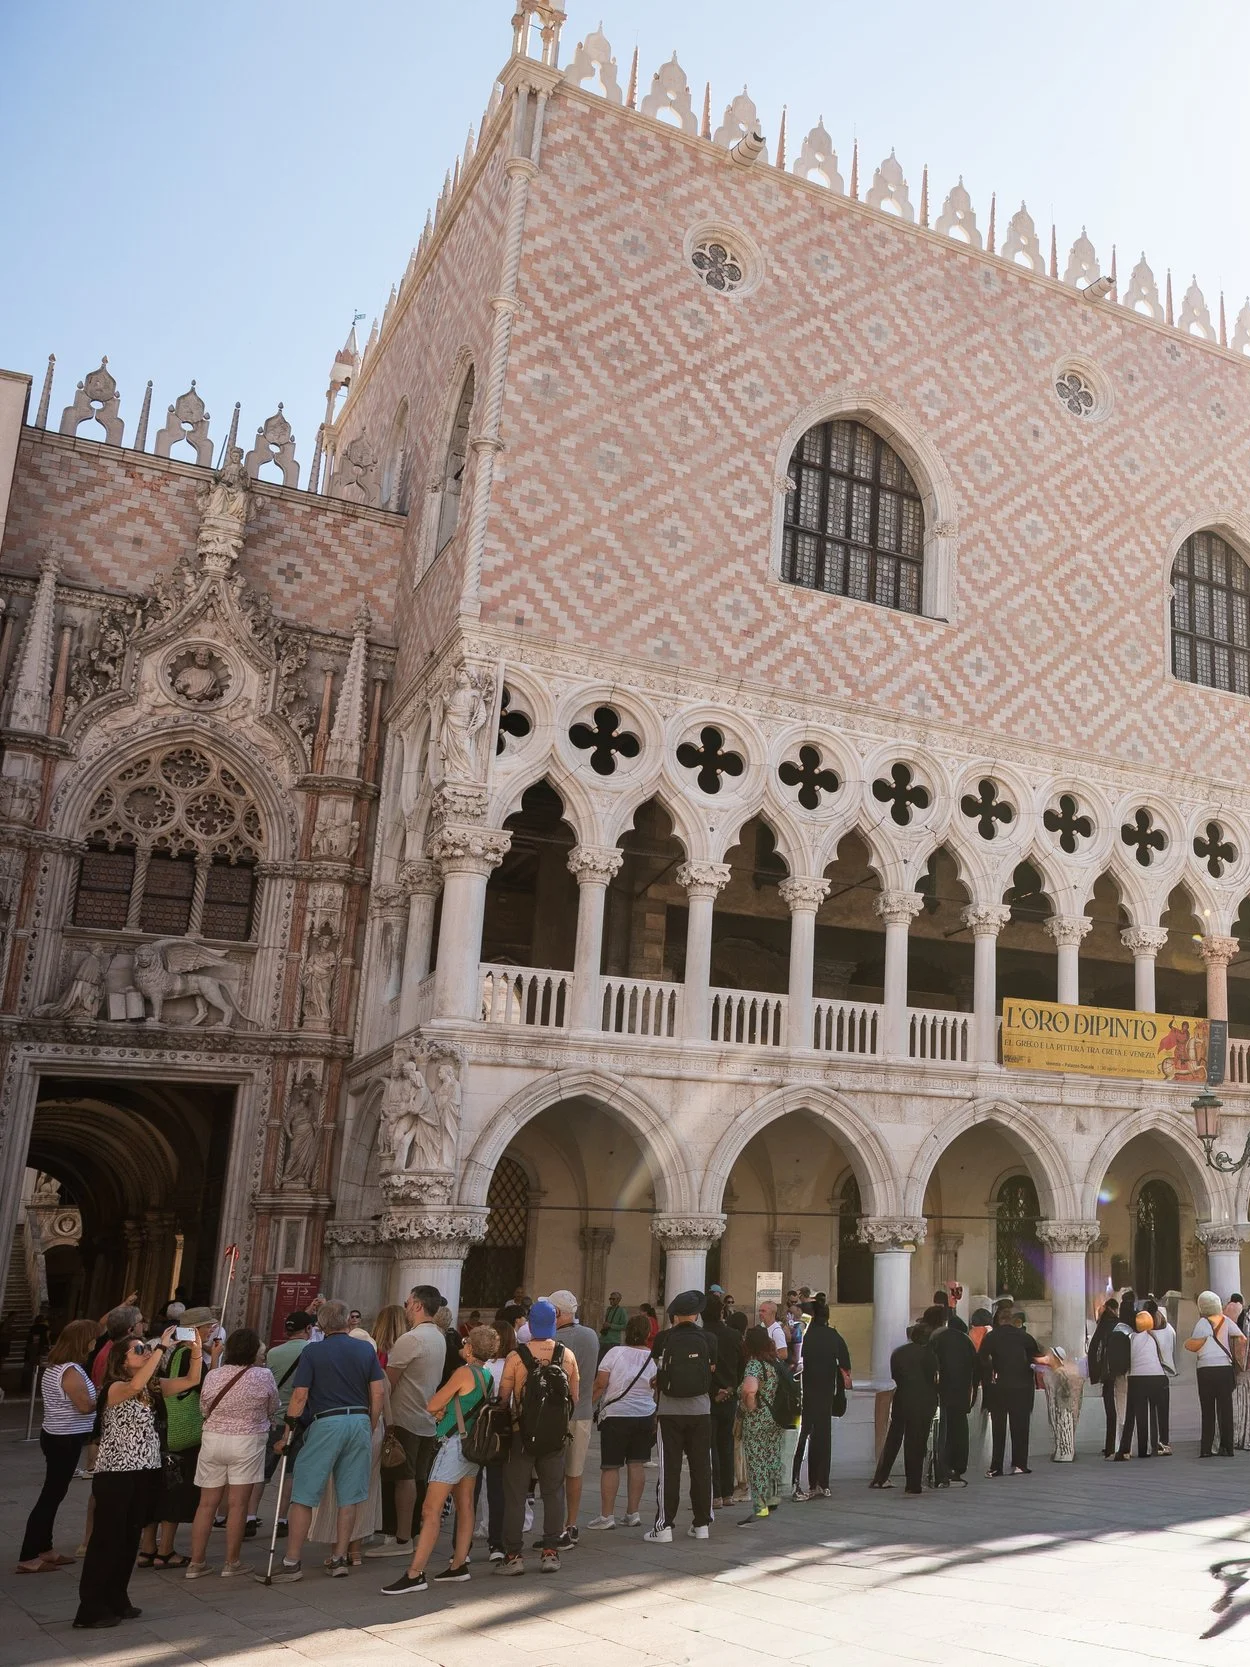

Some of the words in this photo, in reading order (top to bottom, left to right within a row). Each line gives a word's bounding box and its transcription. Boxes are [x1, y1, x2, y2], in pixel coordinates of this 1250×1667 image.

[1007, 1006, 1070, 1033] L'ORO
[1074, 1013, 1157, 1041] DIPINTO
[1016, 1040, 1039, 1048] GRECO
[1040, 1041, 1045, 1049] E
[1057, 1044, 1085, 1053] PITTURA
[1101, 1048, 1121, 1056] CRETA
[1129, 1051, 1156, 1059] VENEZIA
